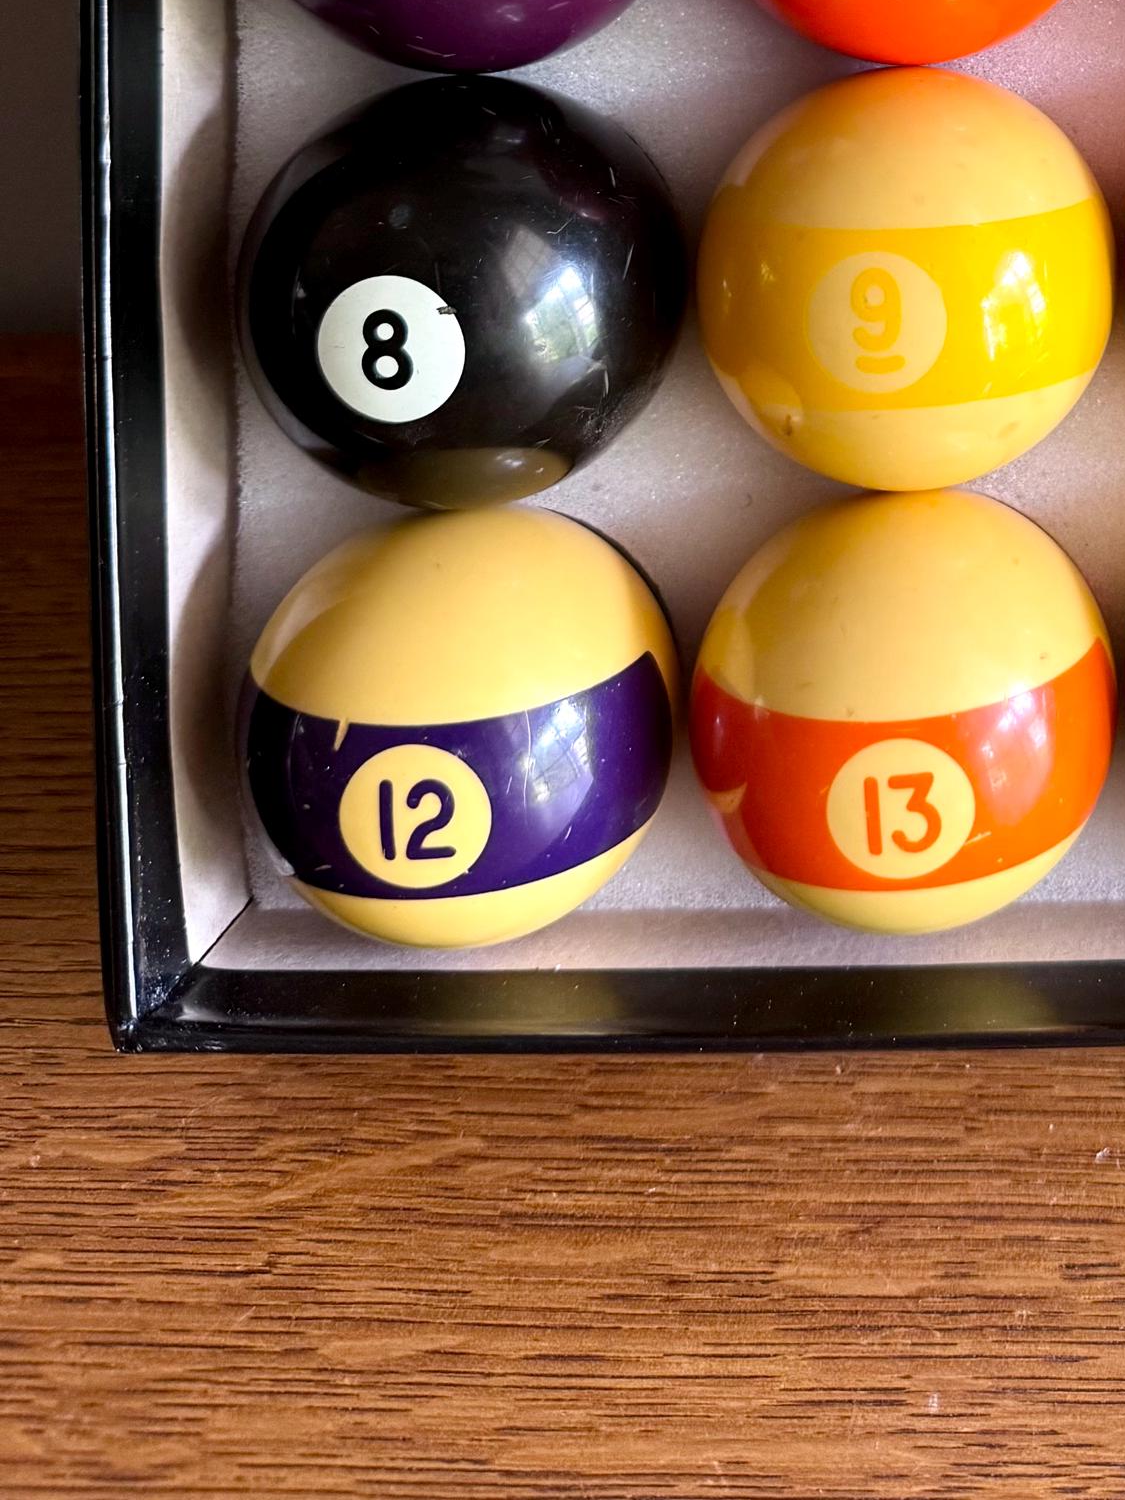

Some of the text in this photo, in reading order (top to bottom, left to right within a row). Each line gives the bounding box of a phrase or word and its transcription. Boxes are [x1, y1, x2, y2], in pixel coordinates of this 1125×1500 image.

[361, 308, 413, 390] 8
[849, 267, 901, 374] 9
[380, 779, 457, 862] 12
[864, 772, 941, 855] 13
